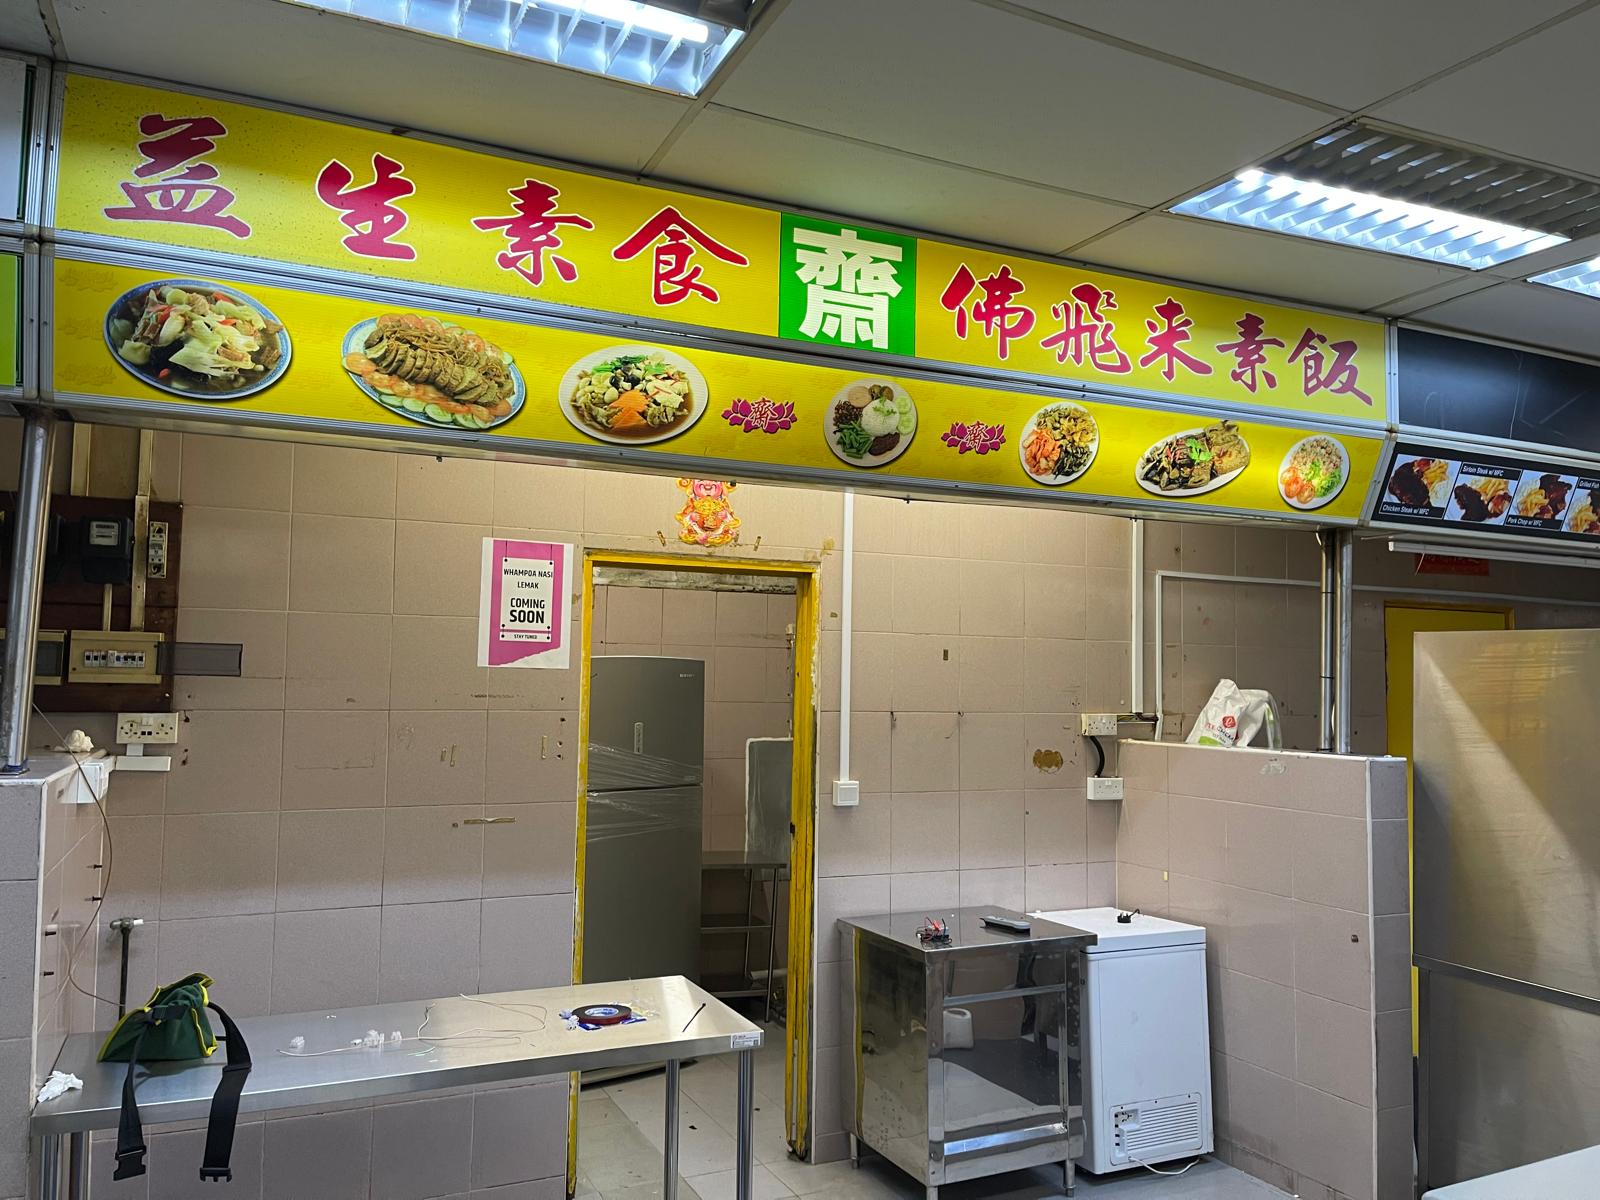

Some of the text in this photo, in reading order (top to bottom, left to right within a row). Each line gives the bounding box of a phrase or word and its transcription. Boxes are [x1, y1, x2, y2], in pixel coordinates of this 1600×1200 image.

[103, 113, 749, 305] 益生素食
[1382, 504, 1400, 512] Chicken
[503, 568, 553, 579] WHAMPOA NASI
[517, 581, 539, 590] LEMAK
[510, 597, 545, 609] COMING
[509, 609, 545, 624] SOON
